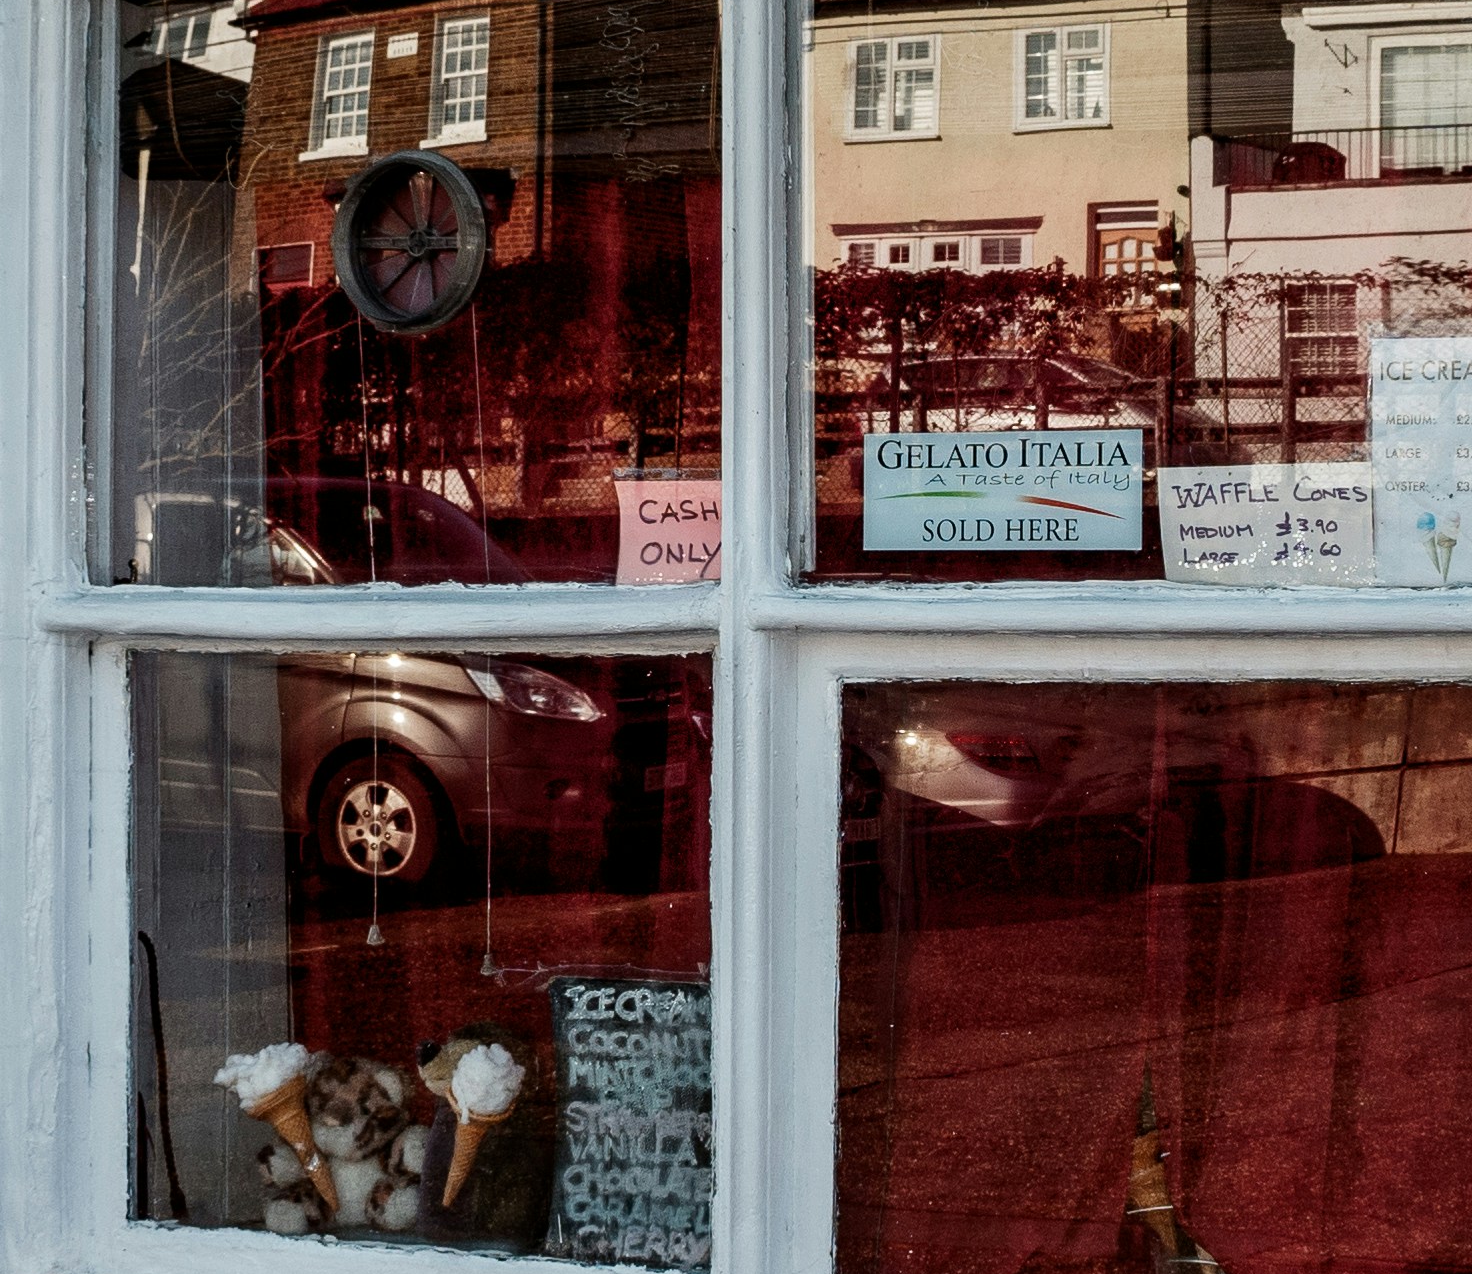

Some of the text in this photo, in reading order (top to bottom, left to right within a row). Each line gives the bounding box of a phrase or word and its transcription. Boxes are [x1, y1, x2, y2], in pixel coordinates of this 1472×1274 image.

[1380, 361, 1412, 381] ICE
[877, 438, 1132, 469] GELATO ITALIA
[925, 469, 1130, 491] A Taste of Italy
[1171, 482, 1280, 509] WAFFLE
[639, 499, 720, 524] CASH
[921, 518, 1080, 543] SOLD HERE
[1179, 511, 1339, 541] MEDIUM £3.90
[640, 541, 722, 578] ONLY
[1183, 547, 1240, 565] LARGE
[565, 985, 616, 1020] ICE
